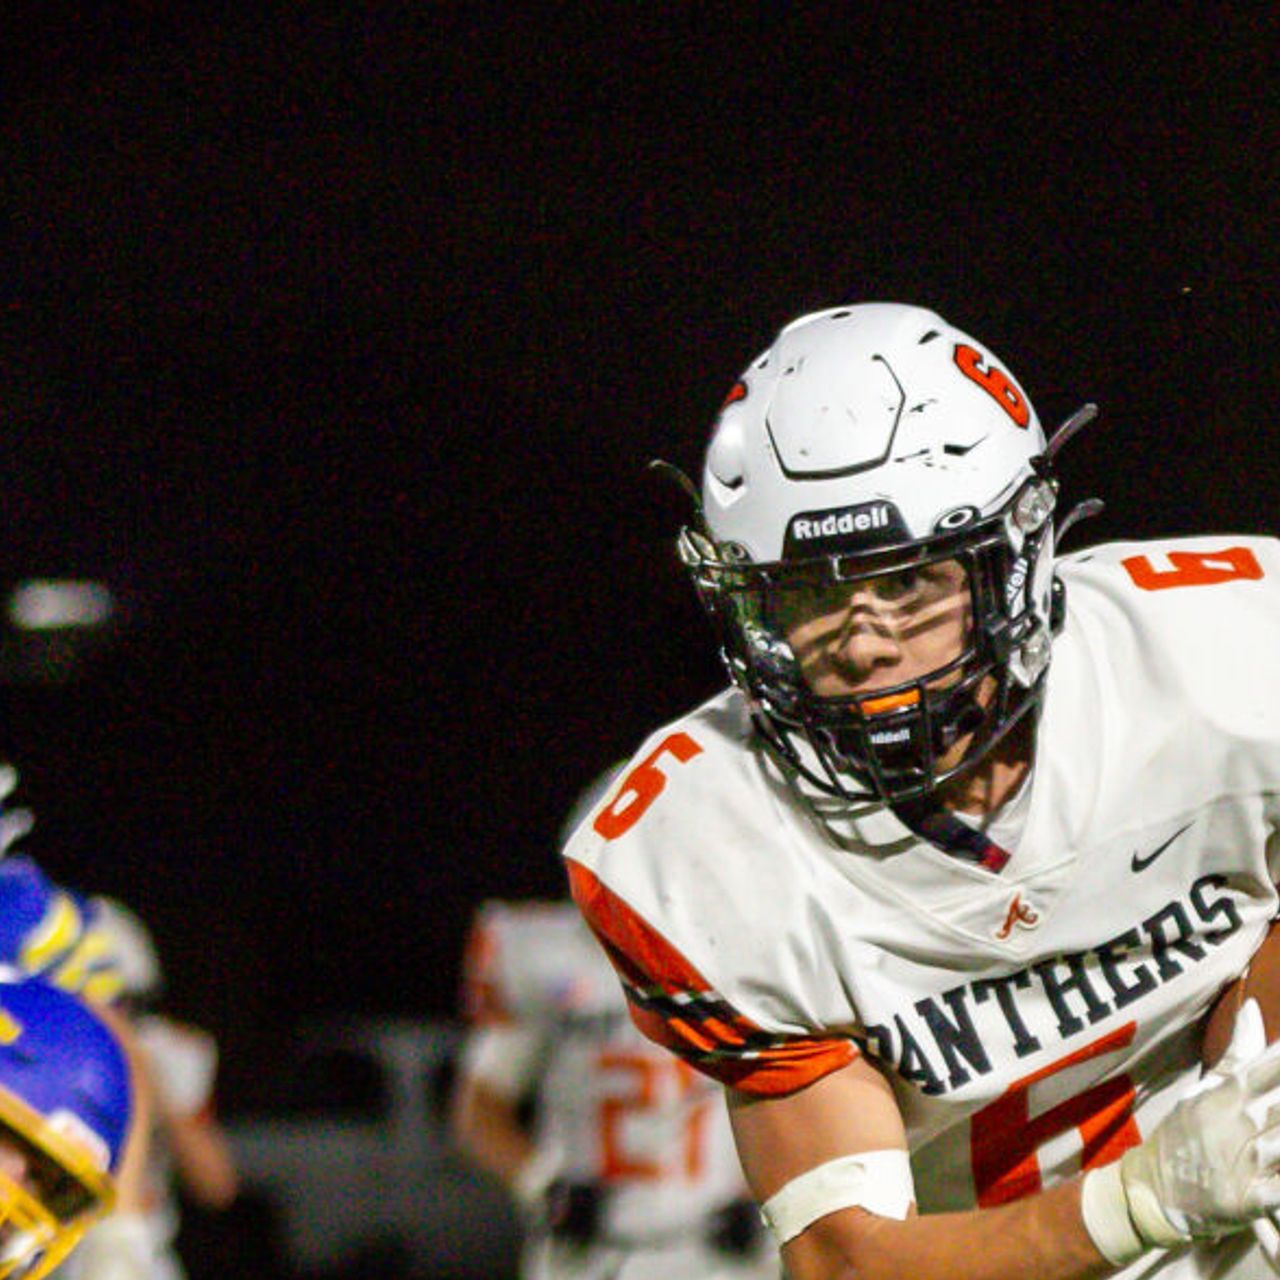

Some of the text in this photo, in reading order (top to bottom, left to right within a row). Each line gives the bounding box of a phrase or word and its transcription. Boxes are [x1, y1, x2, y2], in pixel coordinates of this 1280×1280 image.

[952, 344, 1030, 429] 6
[793, 504, 889, 540] Riddell
[1121, 546, 1265, 592] 6
[593, 731, 705, 842] 6
[970, 1019, 1143, 1210] 6
